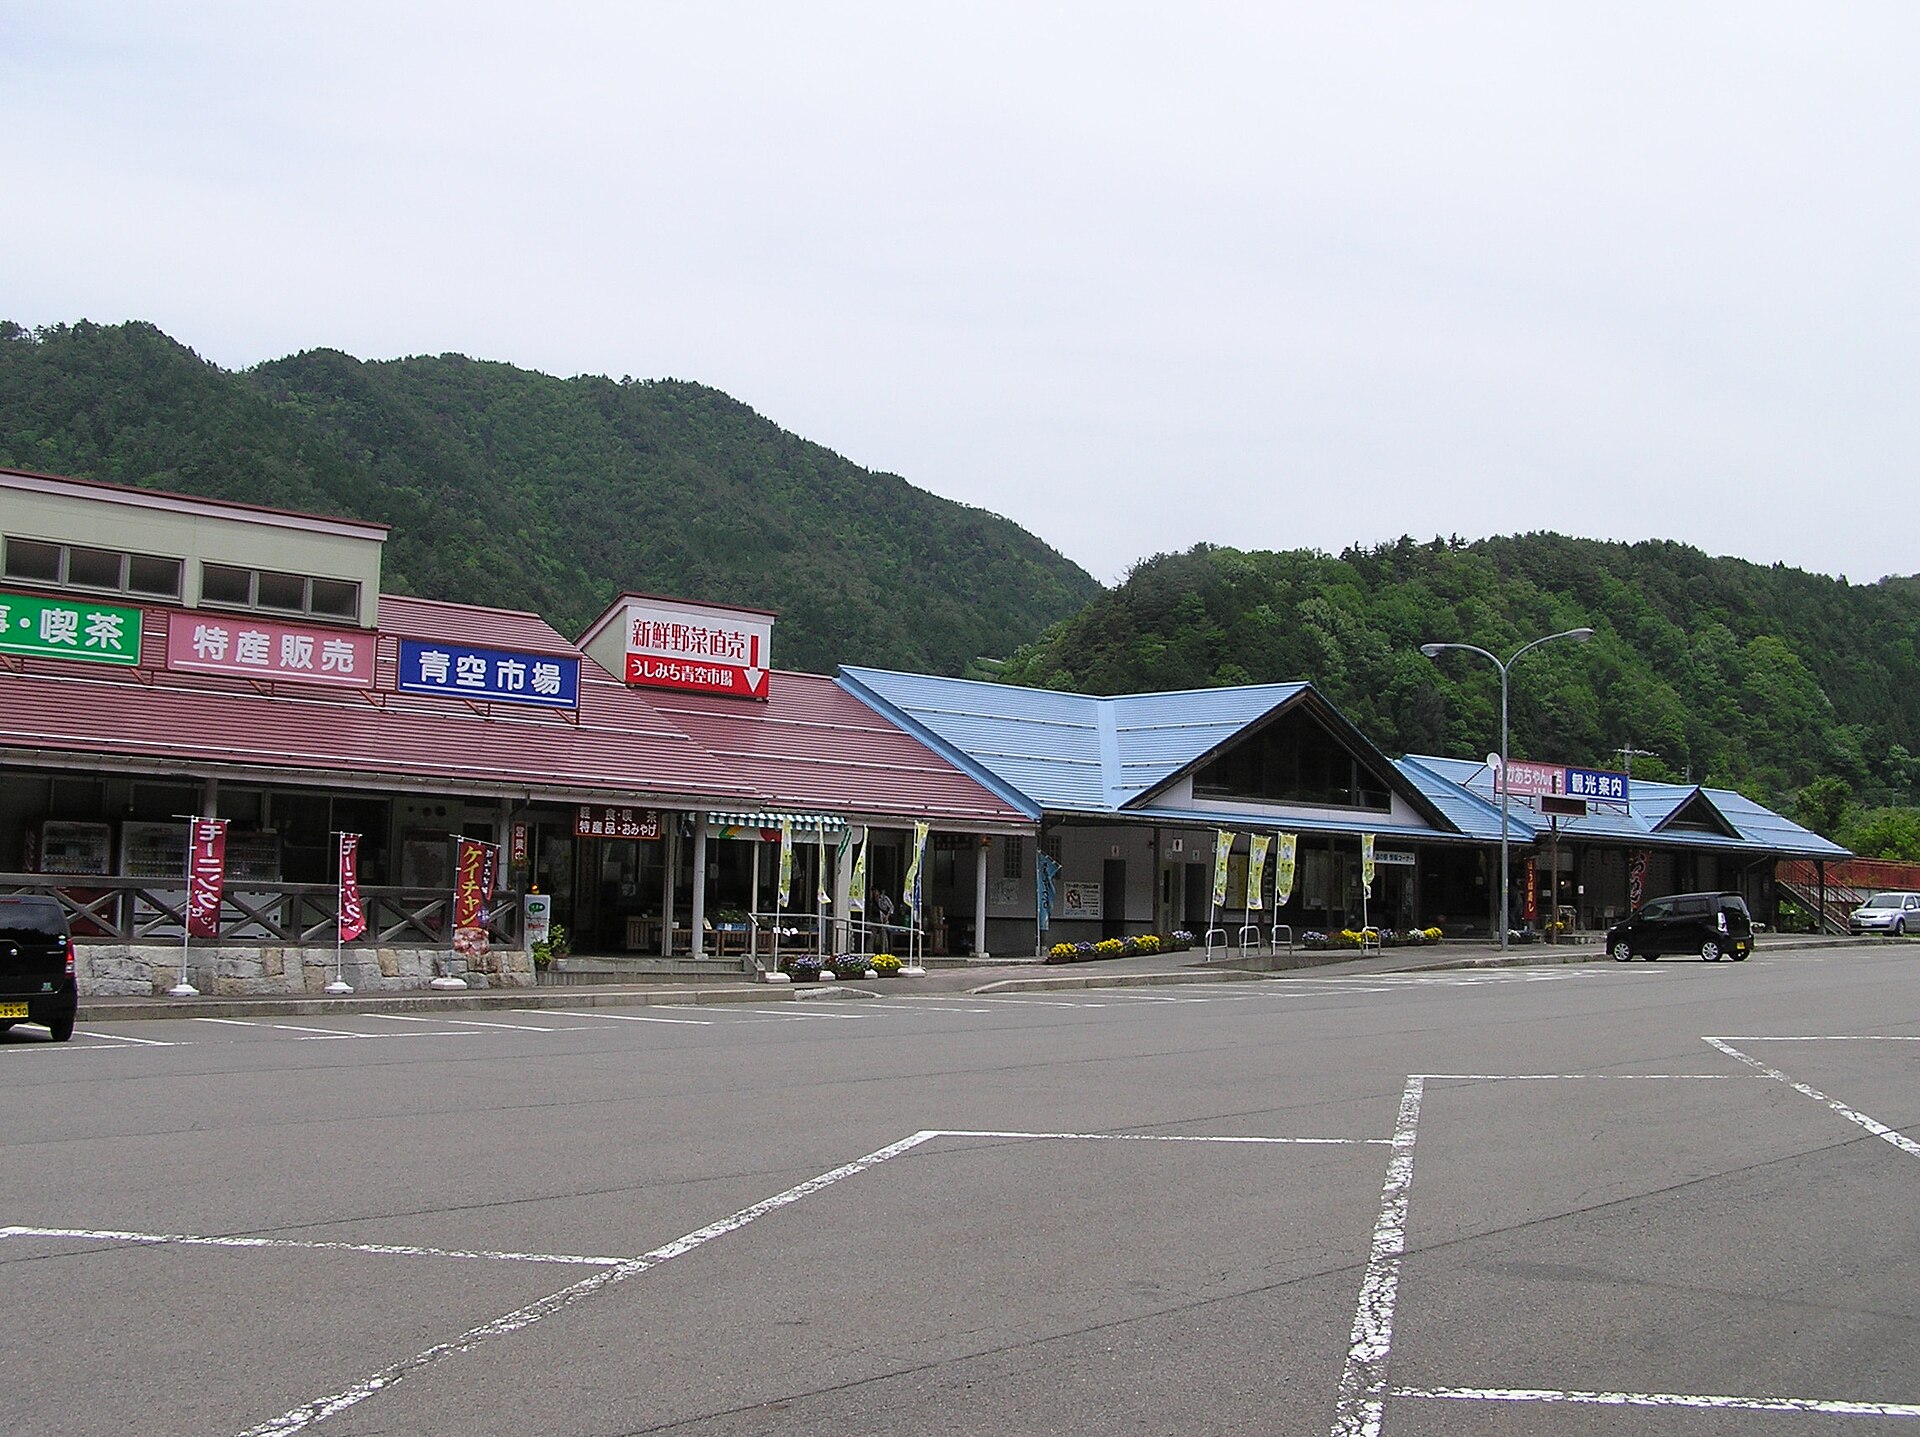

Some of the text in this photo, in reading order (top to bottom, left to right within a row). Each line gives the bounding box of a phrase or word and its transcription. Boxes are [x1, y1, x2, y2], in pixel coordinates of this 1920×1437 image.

[193, 624, 355, 674] 特産販売
[632, 618, 745, 660] 新鮮野菜直売
[418, 649, 562, 696] 青空市場
[630, 659, 733, 687] うしみち青空市場
[1571, 772, 1622, 797] 観光案内
[579, 820, 657, 837] 特産品・おみやげ
[460, 845, 482, 926] ケイチャン
